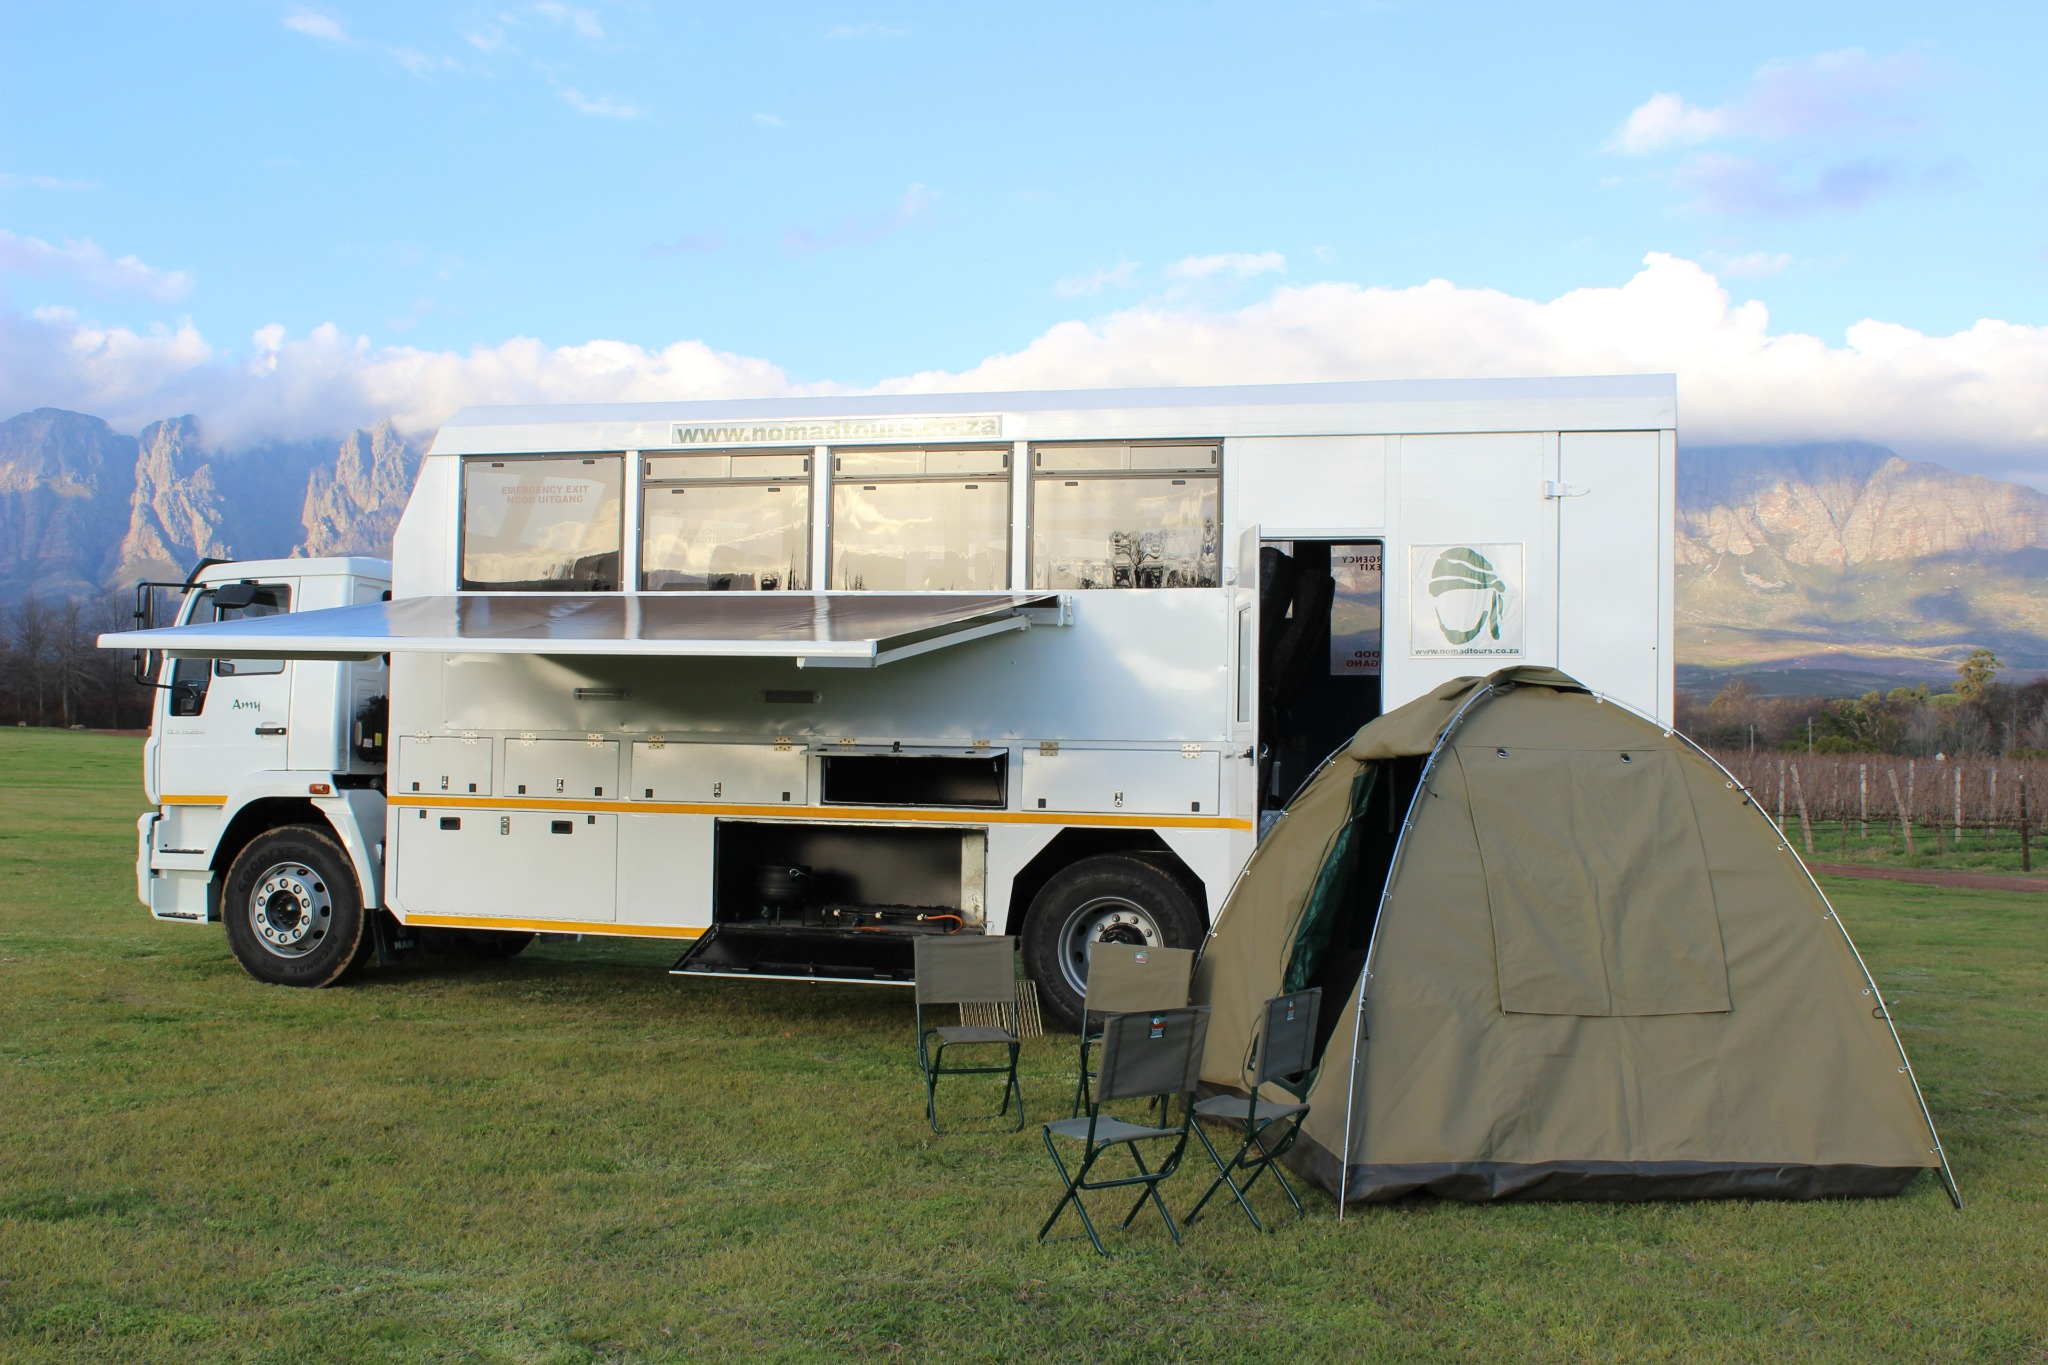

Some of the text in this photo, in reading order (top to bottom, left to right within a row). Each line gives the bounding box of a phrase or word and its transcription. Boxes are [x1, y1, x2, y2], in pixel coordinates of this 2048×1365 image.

[677, 418, 997, 443] www.nomadtours.co.za
[502, 485, 590, 495] EMERGENCY EXIT
[538, 495, 584, 504] UITGANG
[1415, 647, 1519, 655] www.nomadtours.co.za
[232, 699, 260, 712] Amy
[394, 939, 414, 950] MAN
